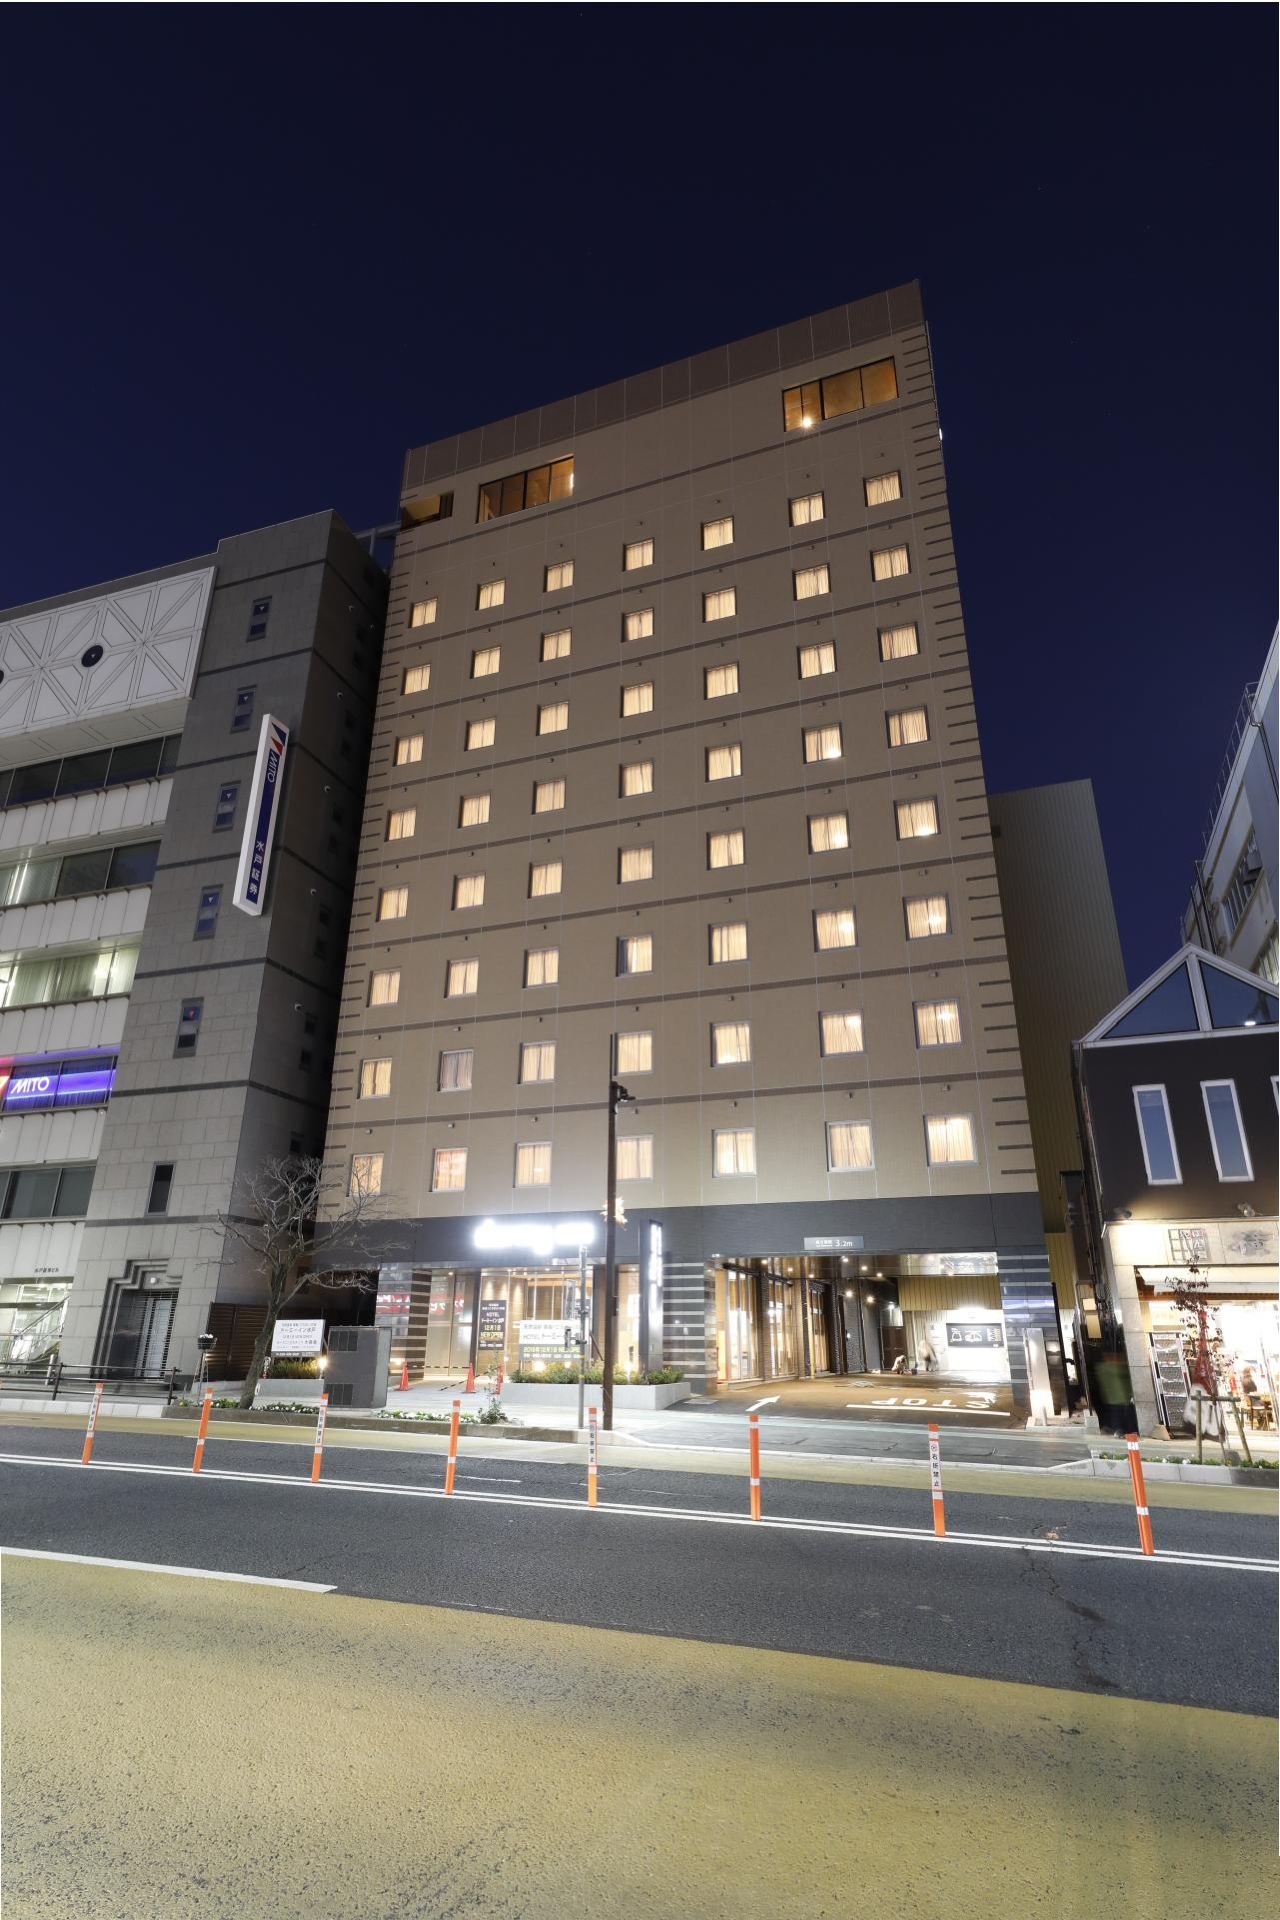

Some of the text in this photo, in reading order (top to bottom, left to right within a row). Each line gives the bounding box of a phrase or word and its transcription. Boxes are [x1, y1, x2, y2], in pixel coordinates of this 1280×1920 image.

[267, 750, 279, 783] MITO
[10, 1076, 50, 1094] MITO
[835, 1239, 853, 1247] 3.2m
[871, 1397, 990, 1410] STOP
